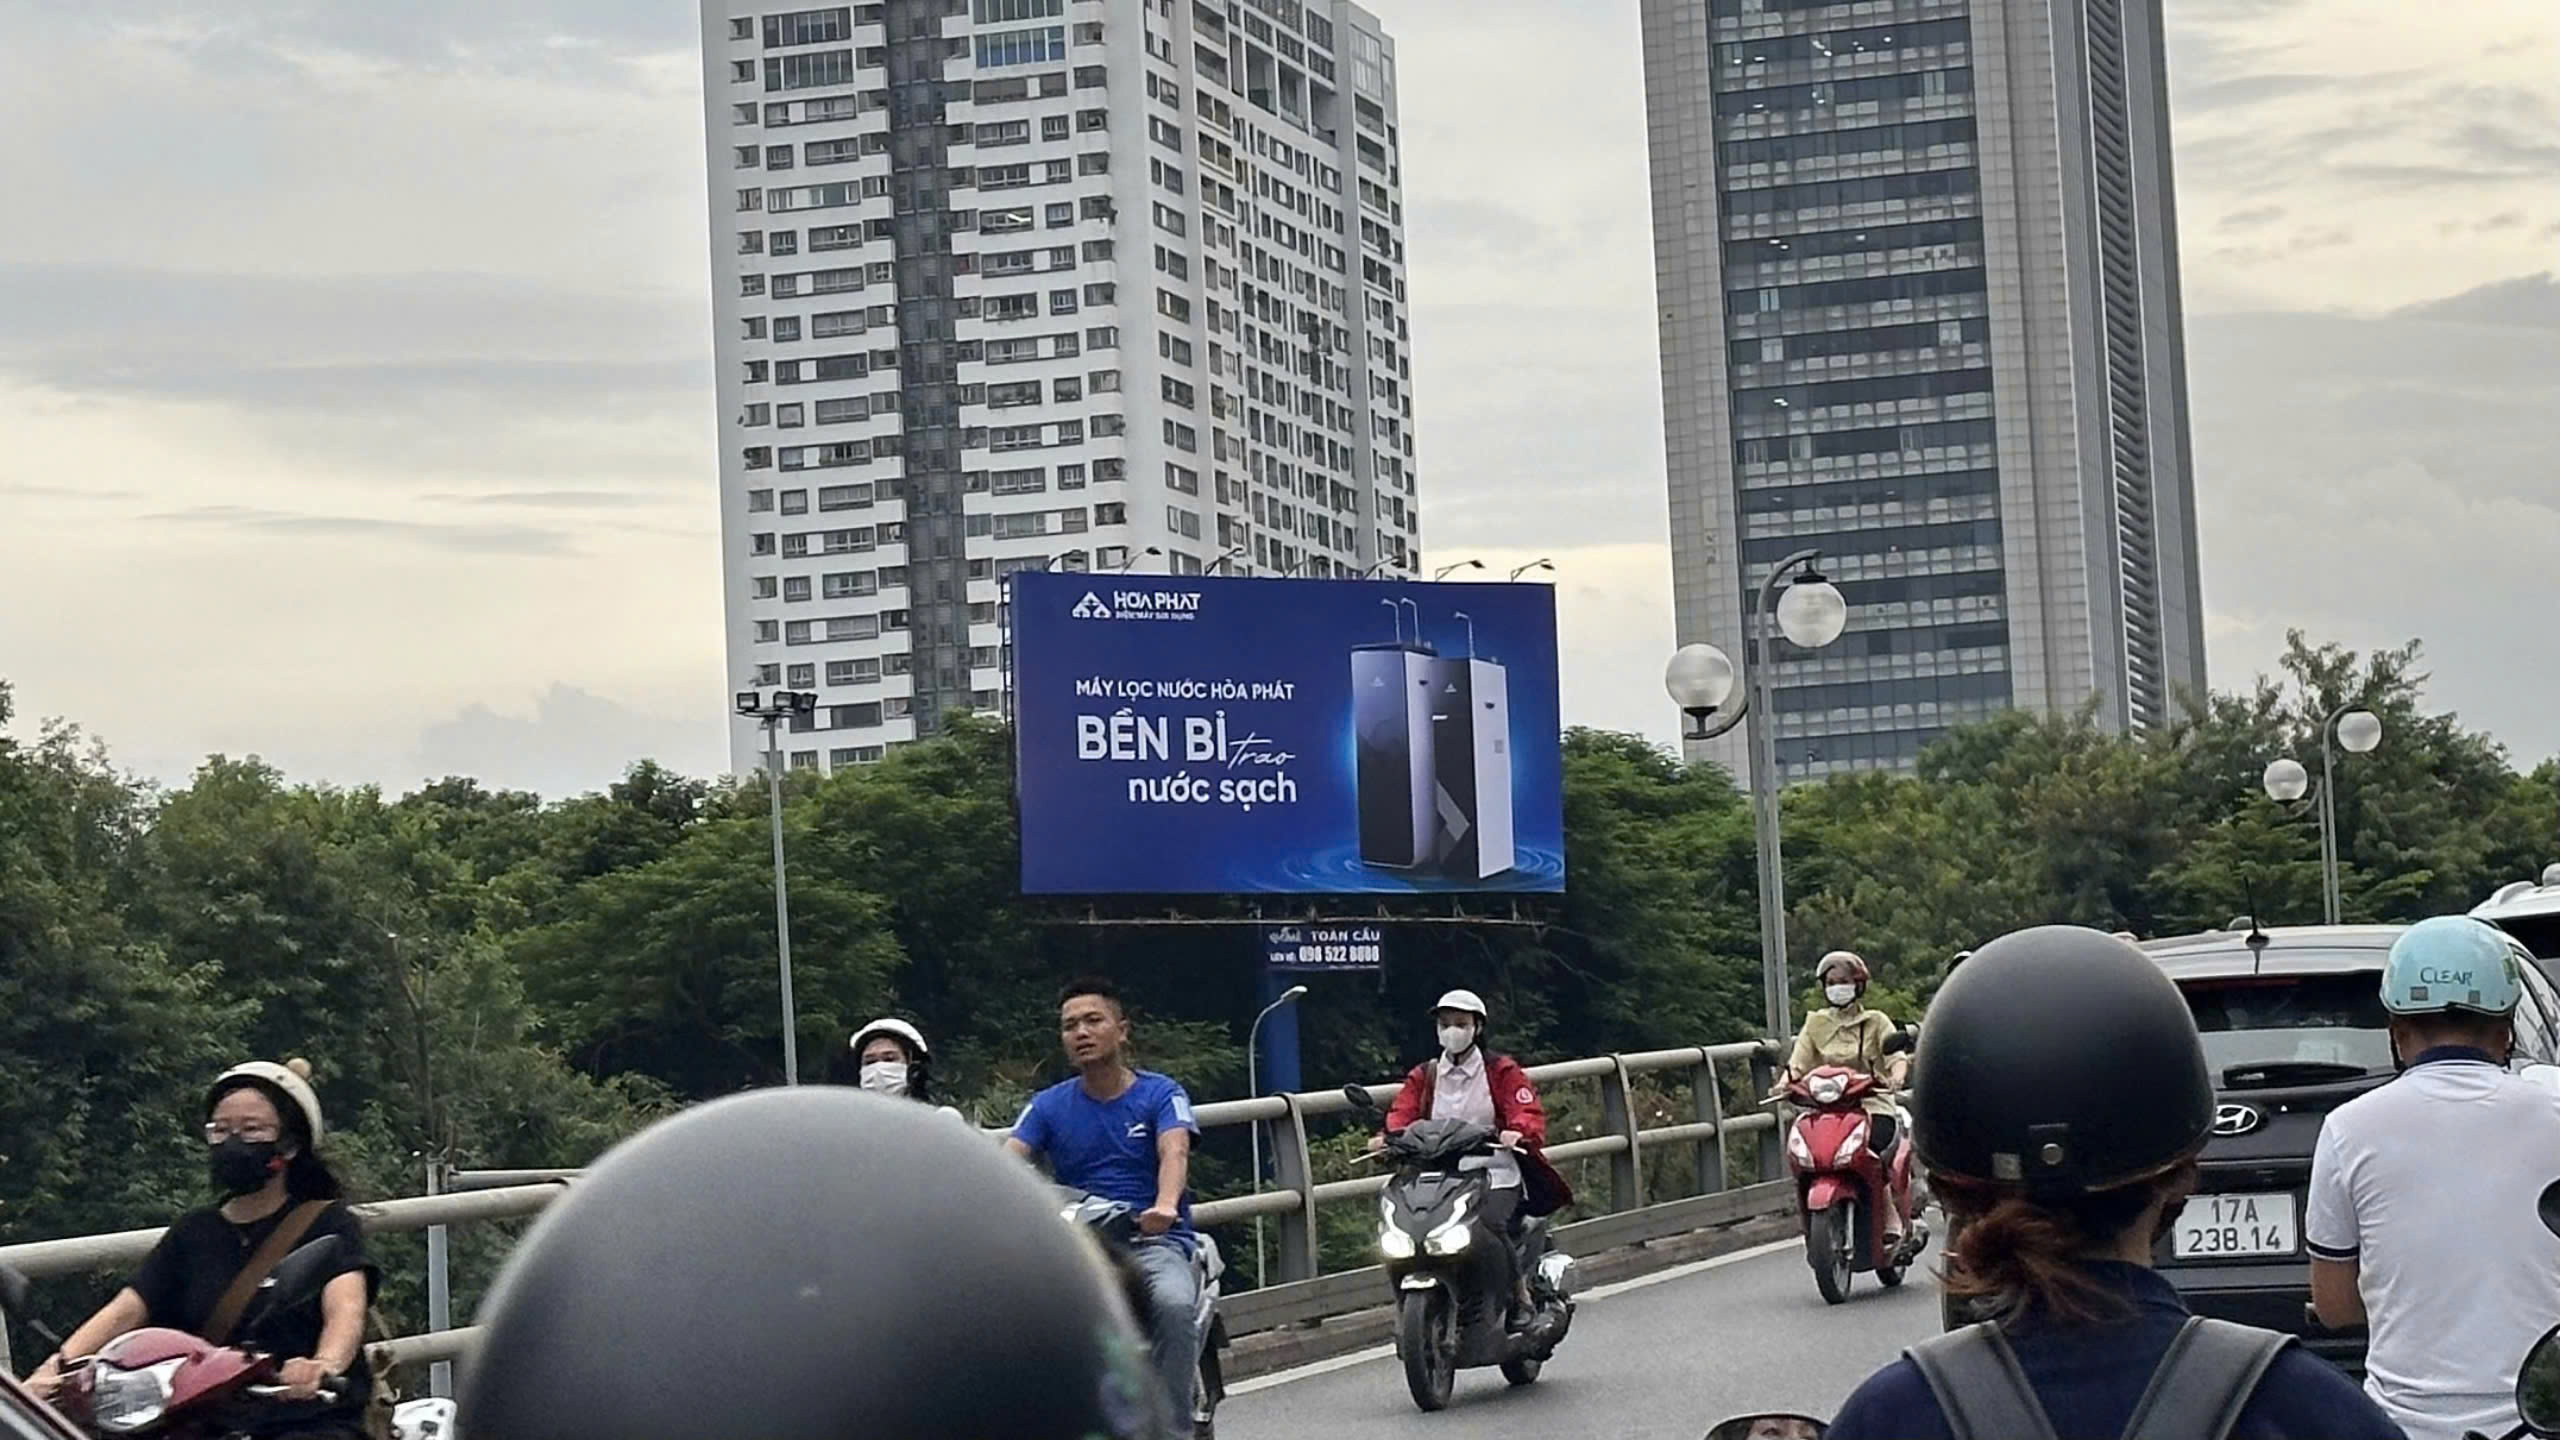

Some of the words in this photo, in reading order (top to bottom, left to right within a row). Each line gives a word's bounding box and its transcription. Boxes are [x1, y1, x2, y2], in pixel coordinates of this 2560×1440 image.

[1076, 676, 1114, 697] MÁY
[1118, 680, 1153, 702] LỌC
[1157, 678, 1207, 699] NƯỚC
[1211, 679, 1248, 699] HÒA
[1252, 680, 1295, 700] PHÁT
[1077, 707, 1169, 761] BỀN
[1184, 710, 1228, 762] BỈ
[1227, 731, 1297, 771] trao
[1128, 770, 1210, 803] nước
[1219, 771, 1297, 812] sạch
[1324, 945, 1347, 962] 522
[2420, 967, 2473, 986] CLEAR
[2211, 1198, 2259, 1224] 17A
[2188, 1225, 2281, 1252] 238.14
